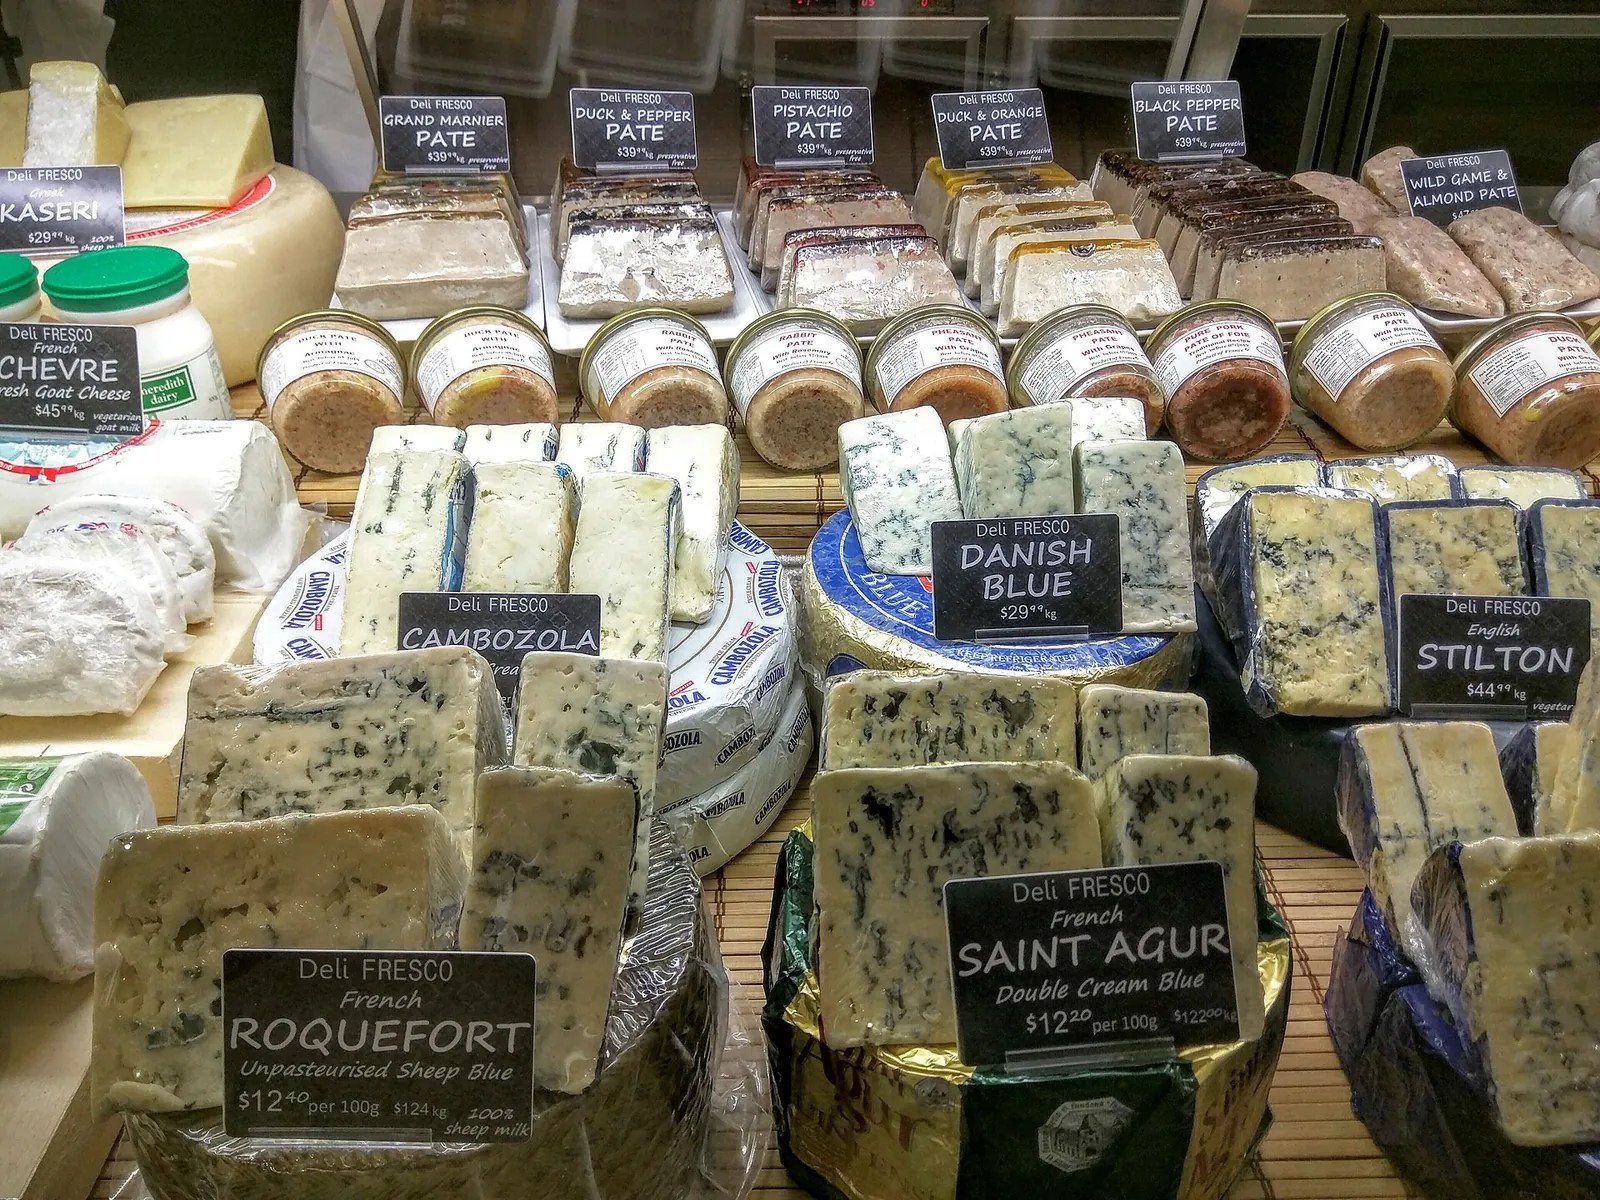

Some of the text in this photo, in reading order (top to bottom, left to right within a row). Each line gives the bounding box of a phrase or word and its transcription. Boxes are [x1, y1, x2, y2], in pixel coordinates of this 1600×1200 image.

[781, 89, 840, 100] Deli FRESCO
[1158, 84, 1212, 94] Deli FRESCO
[410, 99, 473, 110] Deli FRESCO
[600, 92, 661, 104] Deli FRESCO
[958, 92, 1014, 105] Deli FRESCO
[1135, 98, 1241, 113] BLACK PEPPER
[576, 107, 692, 122] DUCK & PEPPER
[773, 104, 853, 118] PISTACHIO
[937, 106, 1043, 123] DUCK & ORANGE
[384, 114, 505, 127] GRAND MARNIER
[1166, 115, 1217, 133] PATE
[416, 130, 476, 148] PATE
[606, 123, 665, 142] PATE
[786, 122, 842, 139] PATE
[969, 123, 1022, 142] PATE
[1426, 155, 1481, 170] Deli FRESCO
[7, 168, 83, 181] Deli FRESCO
[1410, 168, 1508, 190] WILD GAME &
[29, 186, 65, 199] Greek
[1413, 185, 1516, 208] ALMOND PATE
[0, 200, 98, 223] KASERI
[65, 234, 76, 244] kg
[1372, 310, 1406, 321] RABBIT
[1384, 318, 1410, 327] PATE
[10, 326, 92, 342] Deli FRESCO
[661, 330, 697, 342] RABBIT
[779, 332, 818, 342] RABBIT
[931, 329, 982, 342] PHEASANT
[948, 336, 974, 346] PATE
[1072, 328, 1122, 342] PHEASANT
[1091, 336, 1118, 344] PATE
[1184, 324, 1244, 344] PURE PORK
[1184, 336, 1210, 353] PATE
[1211, 332, 1225, 340] OF
[1548, 336, 1582, 344] DUCK
[32, 342, 78, 354] French
[670, 338, 695, 348] PATE
[786, 340, 814, 348] PATE
[935, 344, 957, 352] With
[1081, 346, 1104, 357] With
[1557, 346, 1588, 354] PATE
[0, 356, 119, 383] CHEVRE
[0, 382, 131, 401] resh Goat Cheese
[150, 391, 178, 405] dairy
[73, 409, 86, 422] kg
[92, 412, 142, 422] vegetarian
[96, 423, 141, 434] goat milk
[976, 520, 1070, 537] Deli FRESCO
[730, 521, 770, 555] CAMBO
[960, 538, 1092, 570] DANISH
[758, 560, 784, 617] CAMBOZOLA
[983, 570, 1073, 600] BLUE
[282, 571, 330, 629] CAMBOZOLA
[860, 572, 930, 619] BLUE
[448, 596, 548, 614] Deli FRESCO
[1446, 599, 1541, 616] Deli FRESCO
[1044, 610, 1057, 621] kg
[402, 627, 598, 651] CAMBOZOLA
[1466, 622, 1521, 640] English
[711, 625, 781, 685] CAMBOZOLA
[957, 649, 988, 661] KEEP
[1417, 642, 1574, 673] STILTON
[490, 662, 520, 676] rea
[1514, 689, 1527, 701] kg
[1532, 701, 1574, 713] vegetar
[666, 731, 702, 751] OZOLA
[717, 725, 756, 764] CAMBOZ
[1012, 872, 1151, 903] Deli FRESCO
[1050, 904, 1124, 930] French
[958, 923, 1230, 978] SAINT AGUR
[300, 958, 454, 982] Deli FRESCO
[995, 968, 1206, 1005] Double Cream Blue
[339, 989, 422, 1009] French
[1092, 1019, 1118, 1036] per
[1122, 1014, 1158, 1032] 100g
[230, 1017, 532, 1056] ROQUEFORT
[240, 1060, 514, 1086] Unpasteurised Sheep Blue
[308, 1100, 336, 1116] per
[340, 1100, 380, 1118] 100g
[393, 1102, 430, 1117] $124
[432, 1106, 448, 1120] kg
[467, 1108, 514, 1121] 100%
[443, 1122, 530, 1140] sheep milk
